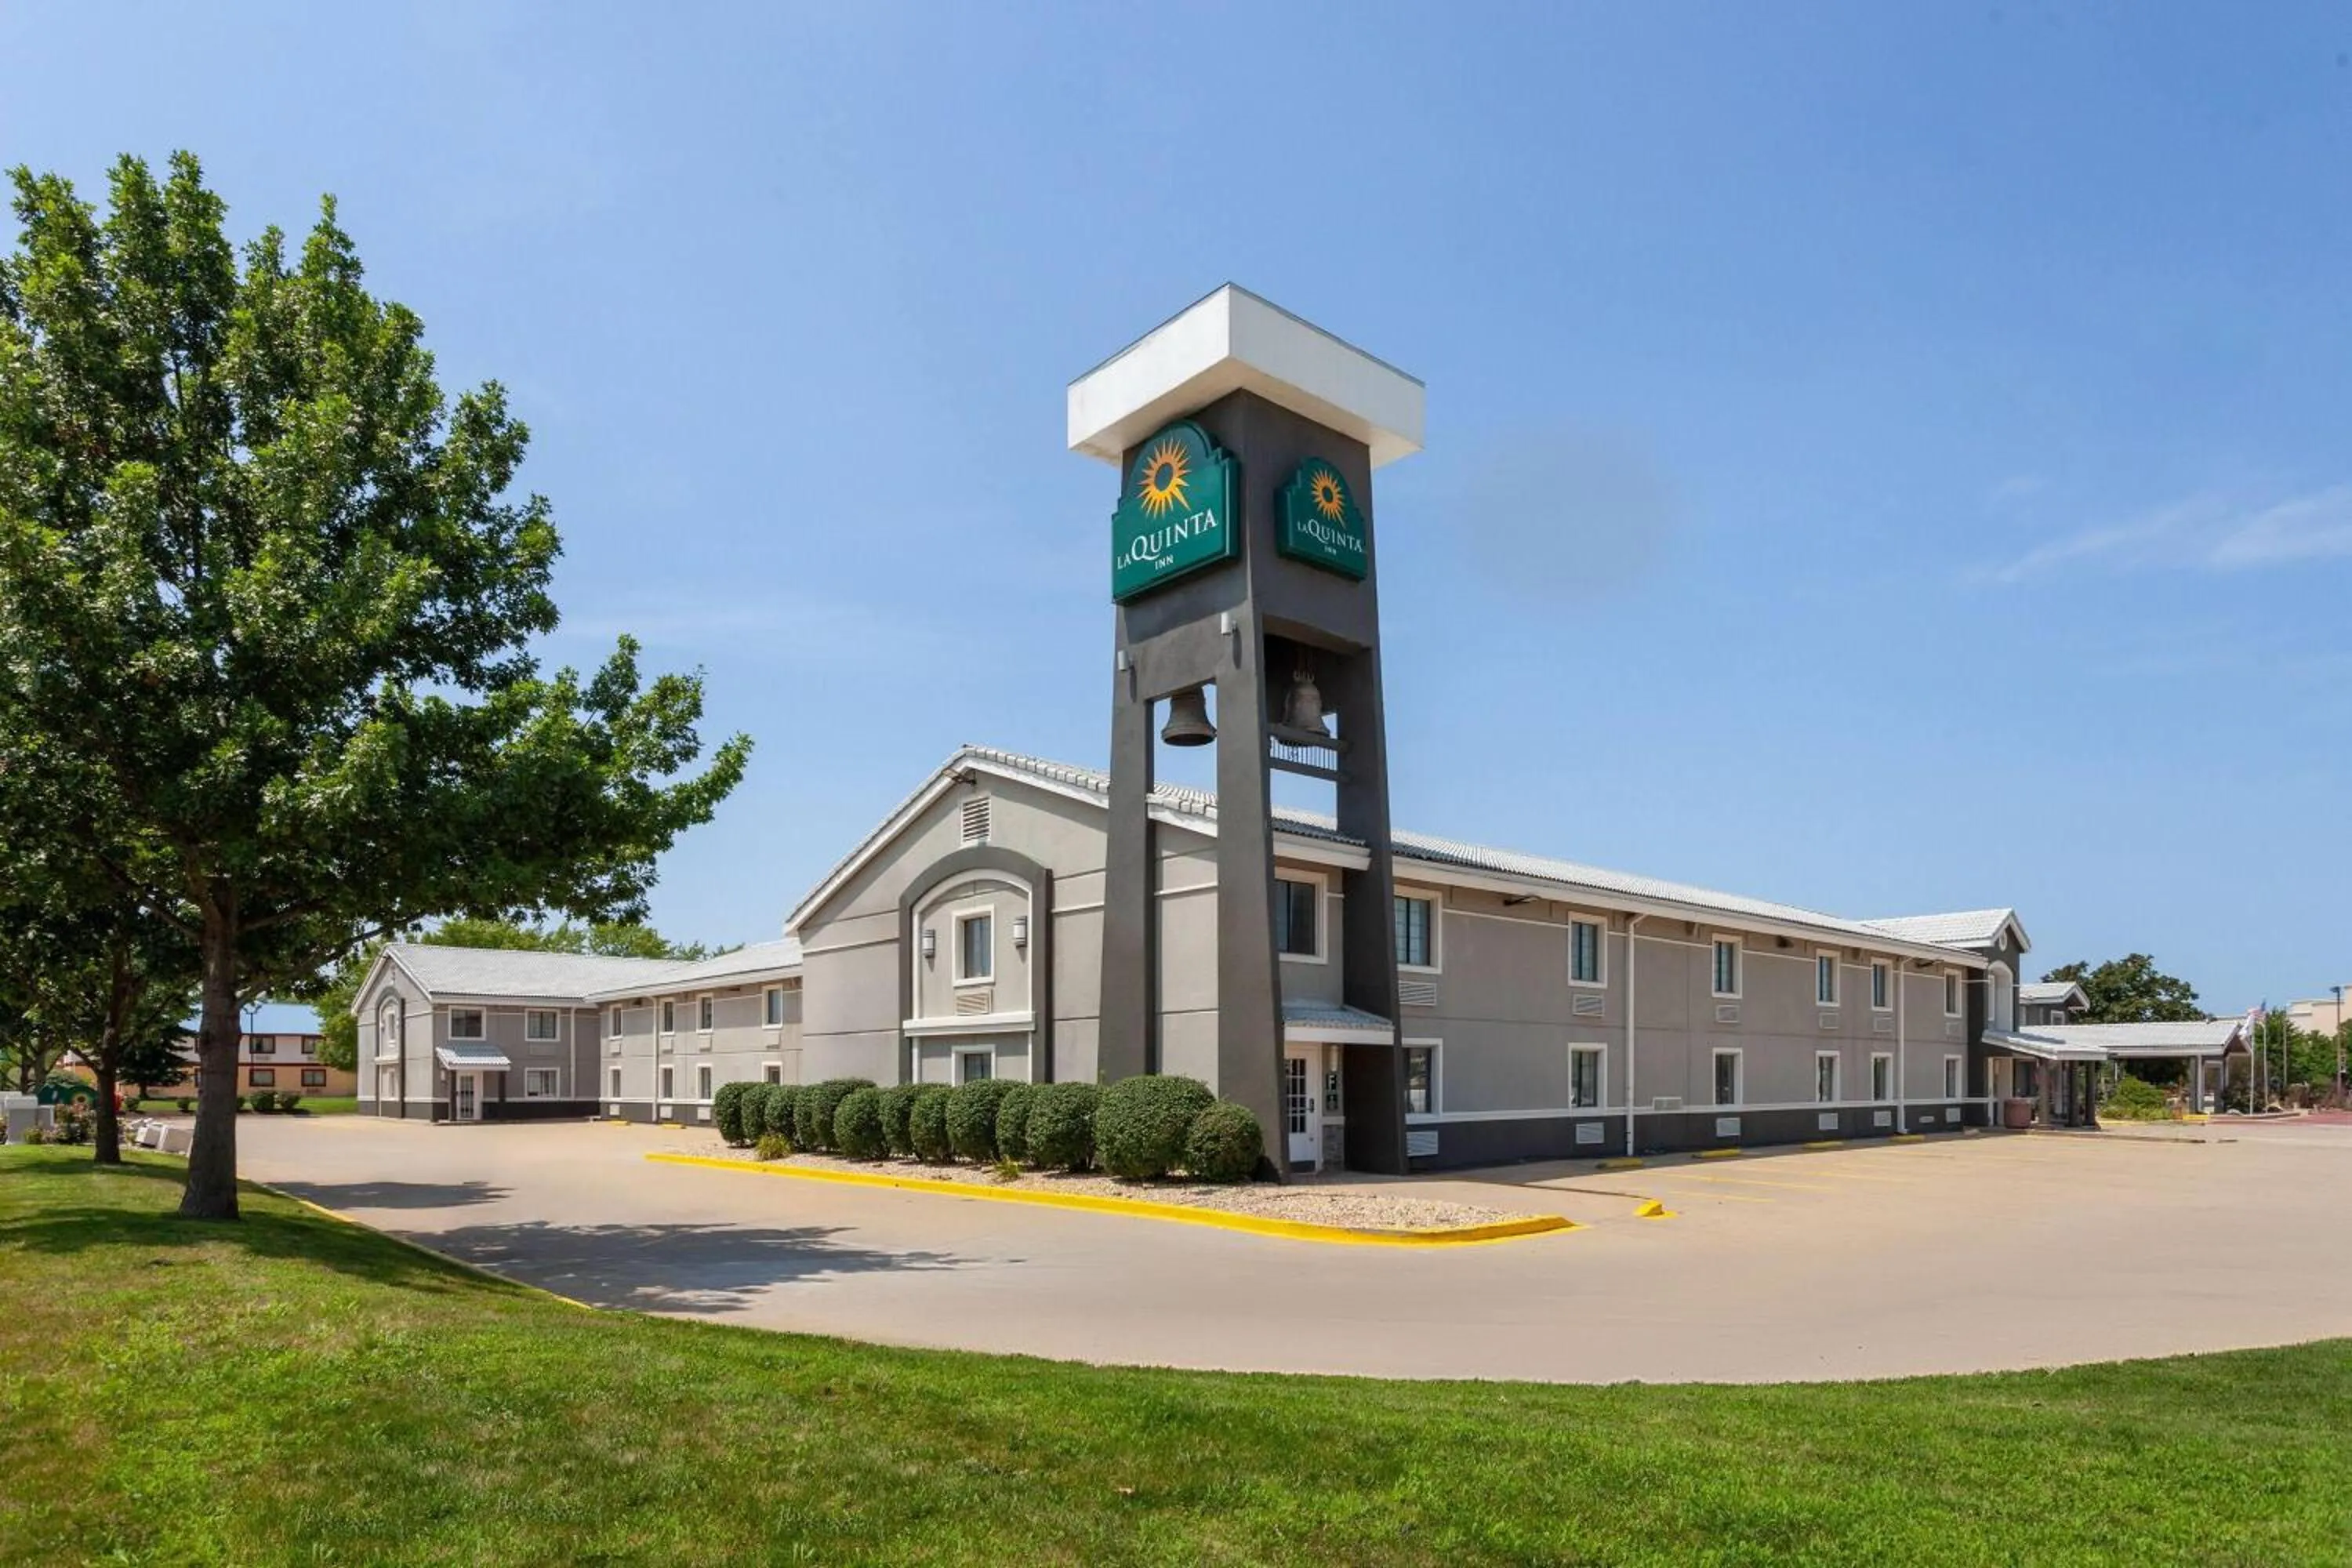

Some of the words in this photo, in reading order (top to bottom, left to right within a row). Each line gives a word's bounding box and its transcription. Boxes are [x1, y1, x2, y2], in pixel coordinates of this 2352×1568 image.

[1117, 553, 1131, 570] LA
[1131, 507, 1218, 561] QUINTA
[1297, 521, 1308, 534] LA
[1308, 518, 1363, 553] QUINTA
[1155, 554, 1174, 570] INN
